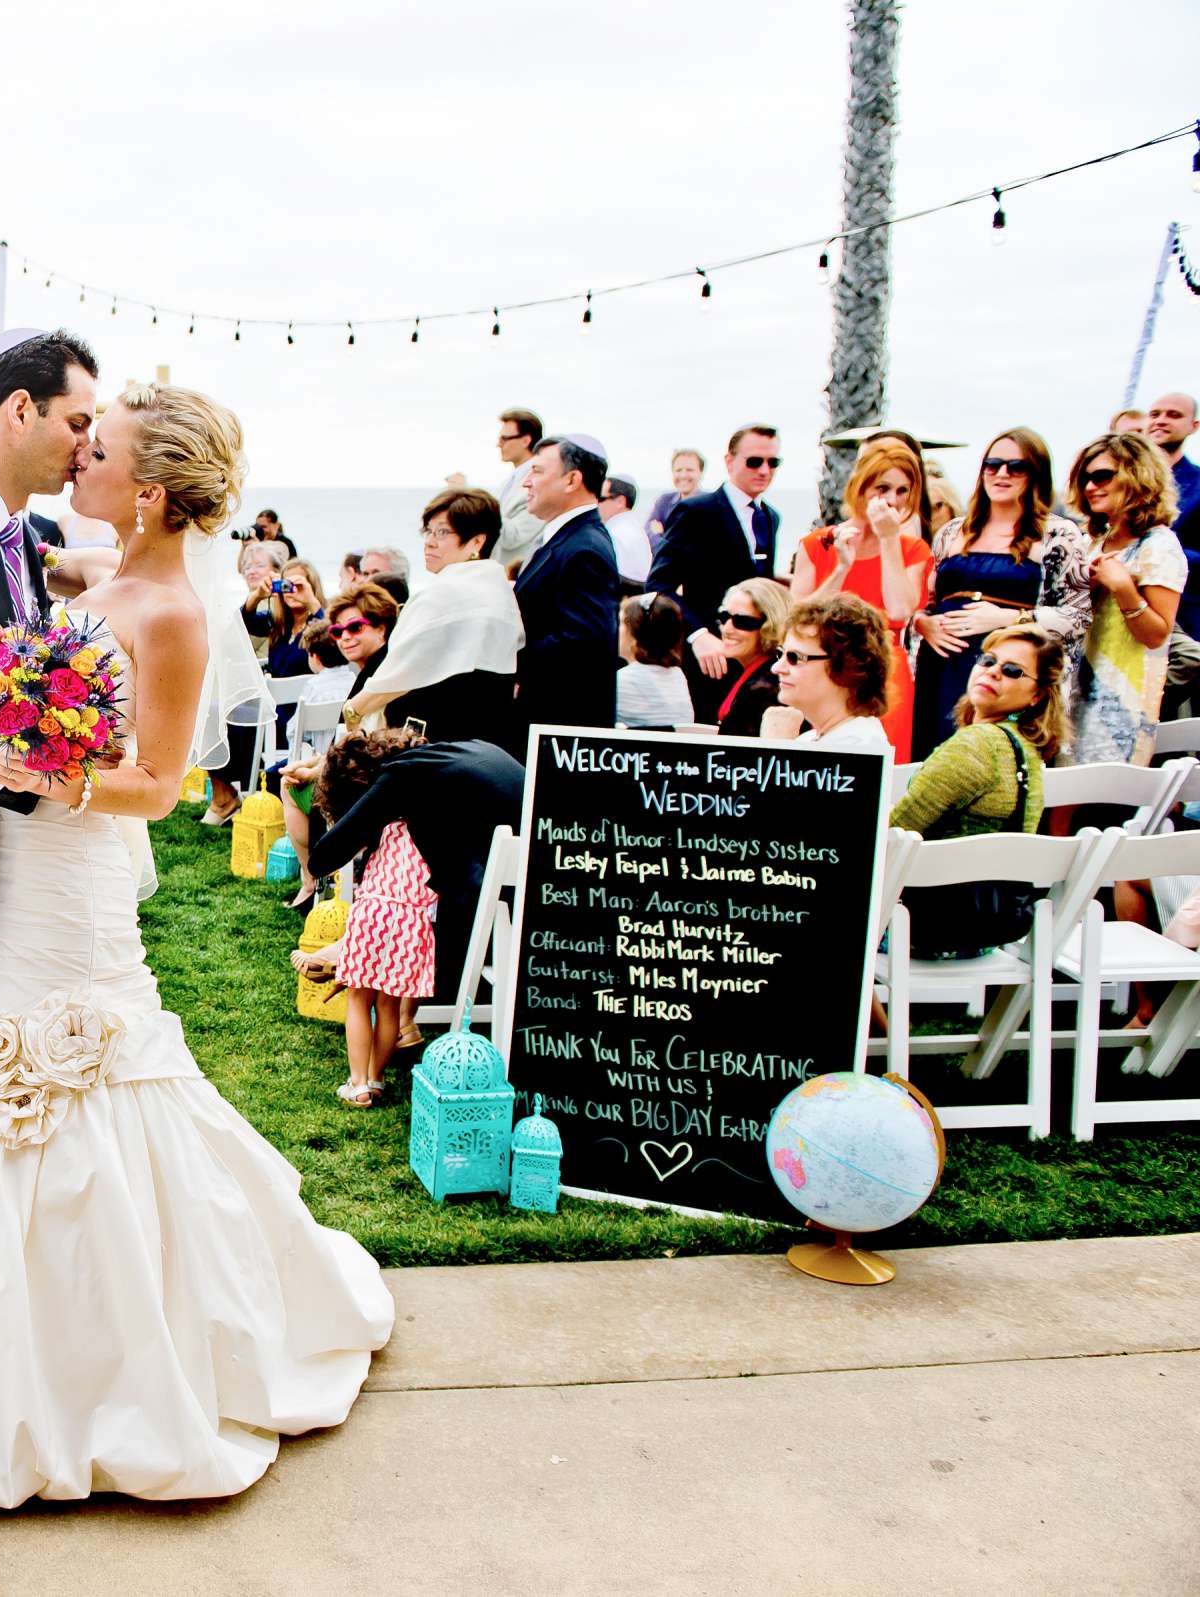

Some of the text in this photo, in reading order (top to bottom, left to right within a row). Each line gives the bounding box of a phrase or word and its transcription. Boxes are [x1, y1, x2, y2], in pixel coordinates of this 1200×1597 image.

[552, 738, 855, 792] WELCOME to the Feipel/Hurvitz
[640, 780, 750, 817] WEDDING
[538, 818, 586, 844] Maids
[591, 819, 610, 843] of
[614, 823, 672, 848] Honor:
[555, 845, 608, 879] Lesley
[616, 852, 668, 883] Feipel
[691, 856, 756, 882] Jaime
[761, 866, 816, 890] Babin
[542, 884, 578, 906] Best
[646, 891, 718, 916] Aaron's
[728, 899, 809, 923] brother
[618, 916, 749, 945] Brad Hurvitz
[722, 946, 782, 964] Miller
[629, 966, 676, 989] Miles
[682, 968, 768, 999] Moynier
[526, 986, 692, 1021] Band: THE HEROS
[516, 1026, 583, 1059] THANK
[666, 1034, 817, 1081] CELEBRATING
[608, 1070, 660, 1092] WITH
[668, 1078, 696, 1094] US
